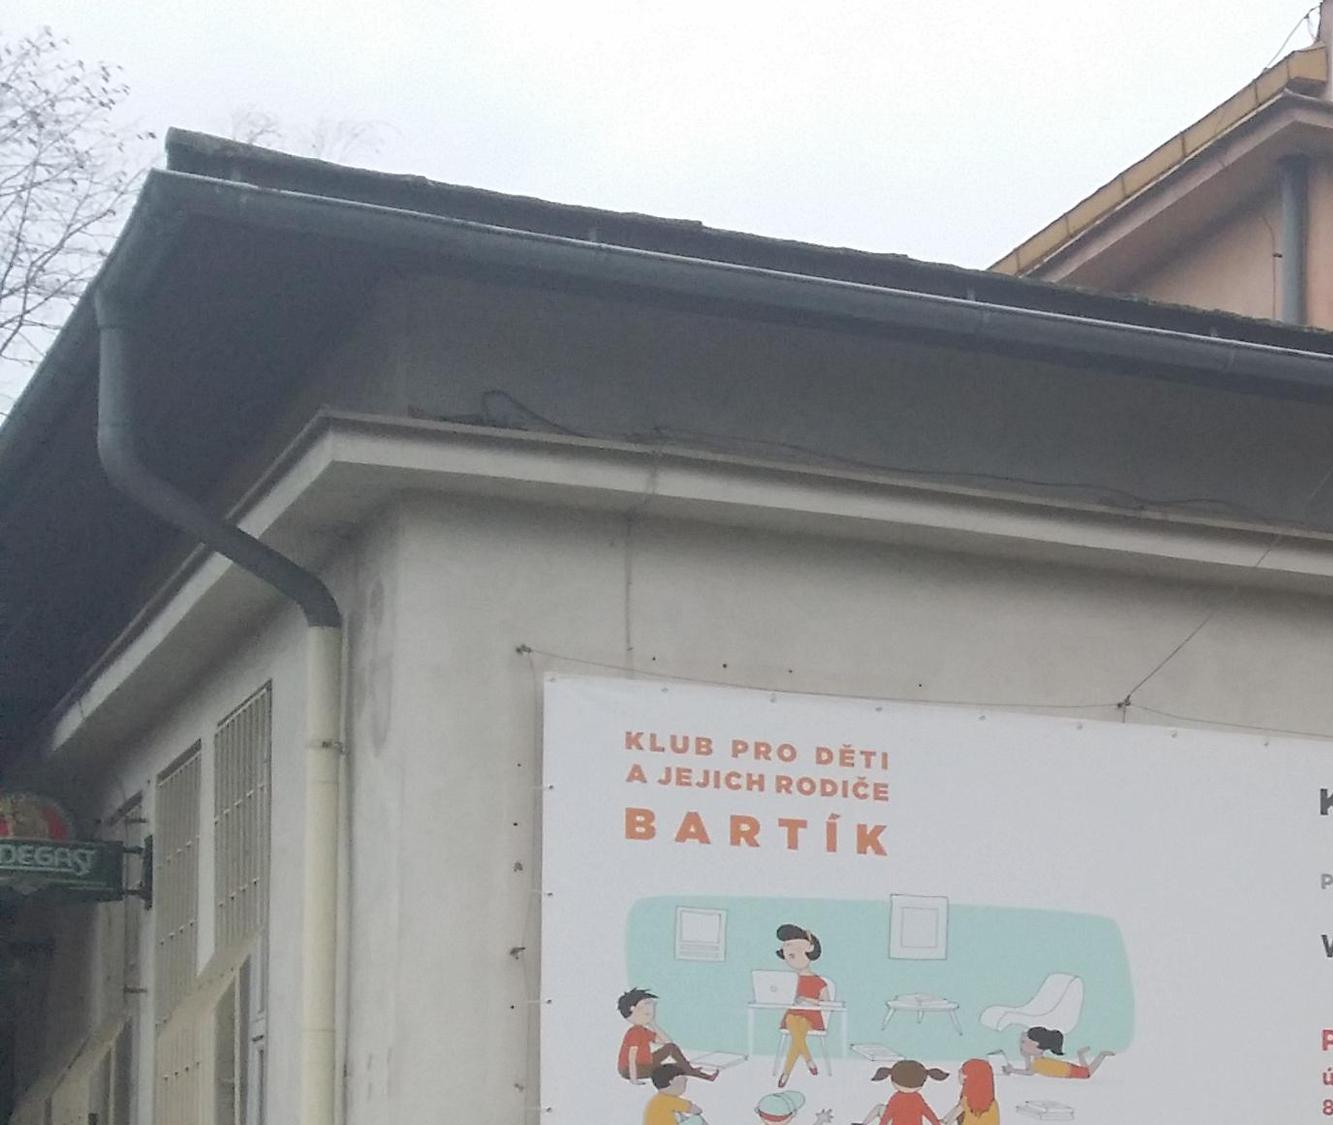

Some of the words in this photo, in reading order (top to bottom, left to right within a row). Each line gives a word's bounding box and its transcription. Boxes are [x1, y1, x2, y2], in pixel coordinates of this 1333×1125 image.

[624, 730, 713, 757] KLUB
[731, 739, 798, 763] PRO
[815, 743, 889, 771] DĚTI
[625, 763, 648, 784] A
[657, 766, 766, 793] JEJICH
[774, 774, 889, 802] RODIČE
[624, 806, 888, 857] BARTÍK
